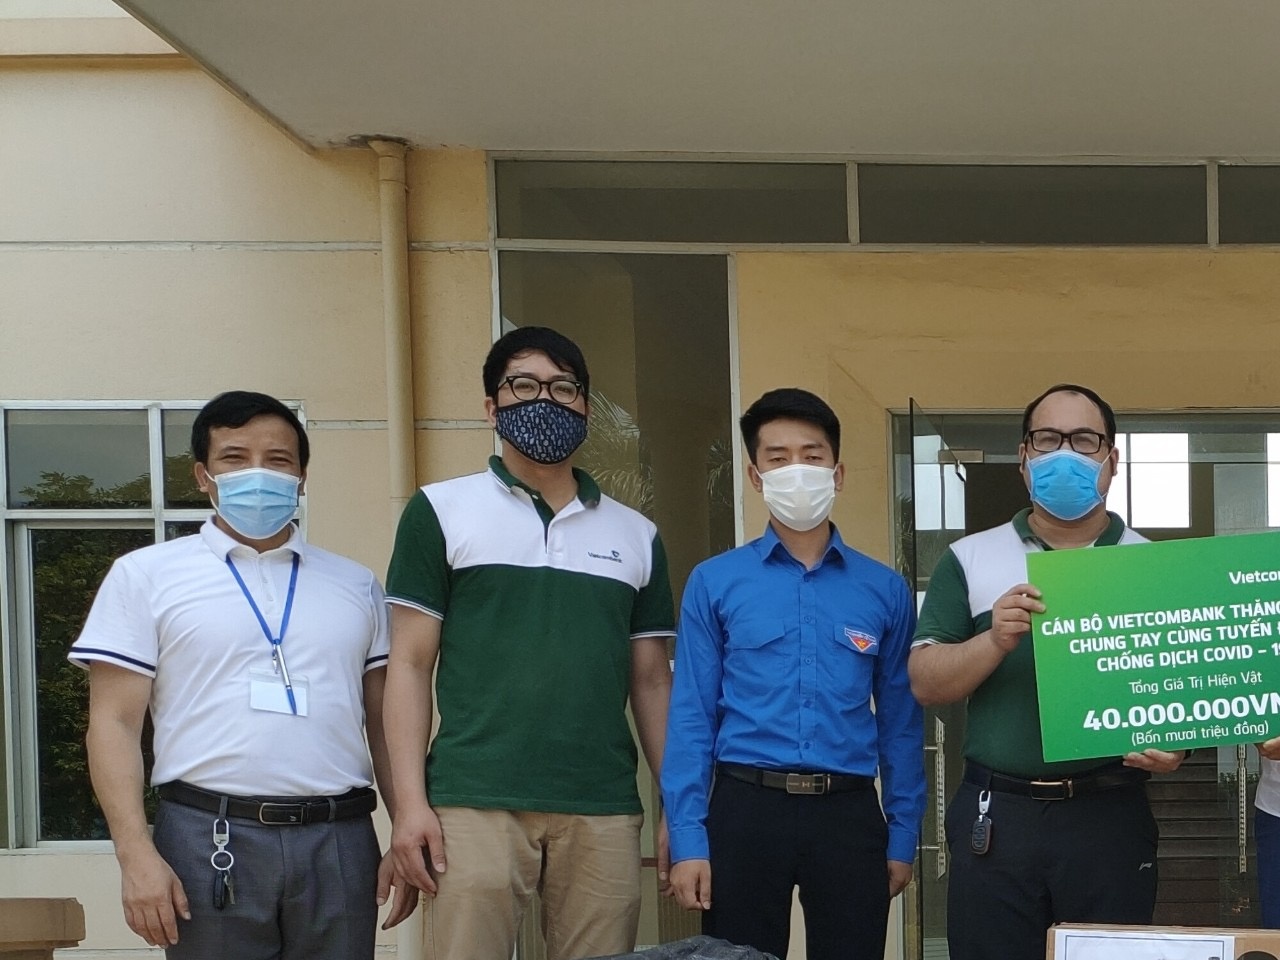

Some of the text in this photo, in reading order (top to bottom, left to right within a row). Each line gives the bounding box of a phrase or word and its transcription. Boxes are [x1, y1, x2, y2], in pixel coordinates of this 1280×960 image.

[1042, 617, 1075, 635] CÁN
[1080, 614, 1102, 634] BỘ
[1108, 606, 1225, 629] VIETCOMBANK
[1070, 636, 1126, 653] CHUNG
[1131, 632, 1161, 647] TAY
[1168, 626, 1211, 644] CÙNG
[1216, 618, 1271, 640] TUYẾN
[1097, 650, 1154, 671] CHỐNG
[1160, 649, 1198, 670] DỊCH
[1204, 645, 1252, 662] COVID
[1129, 670, 1262, 694] Tổng Giá Trị Hiện Vật
[1132, 721, 1268, 745] (Bốn mươi triệu đồng)
